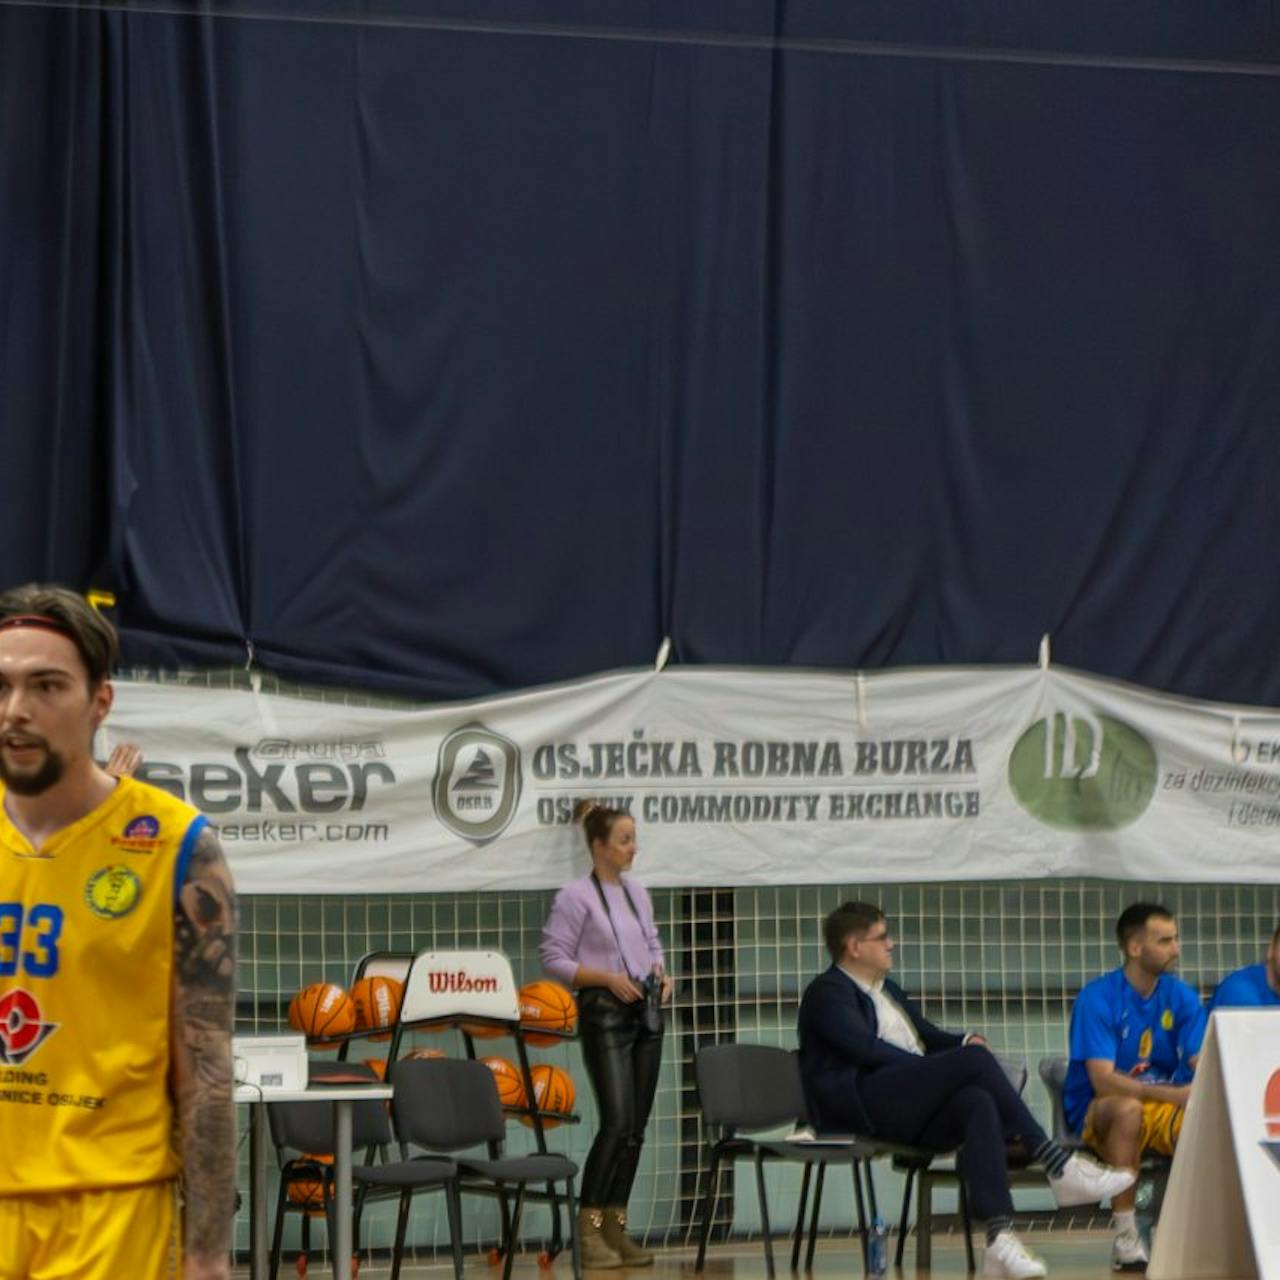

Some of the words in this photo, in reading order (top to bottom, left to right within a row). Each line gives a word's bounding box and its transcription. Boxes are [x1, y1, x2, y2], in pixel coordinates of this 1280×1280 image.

[532, 728, 703, 781] OSJEČKA
[713, 741, 844, 779] ROBNA
[854, 739, 977, 777] BURZA
[137, 744, 396, 814] seker
[642, 793, 822, 826] COMMODITY
[828, 791, 980, 821] EXCHANGE
[208, 820, 389, 842] seker.com
[428, 969, 498, 994] Wilson
